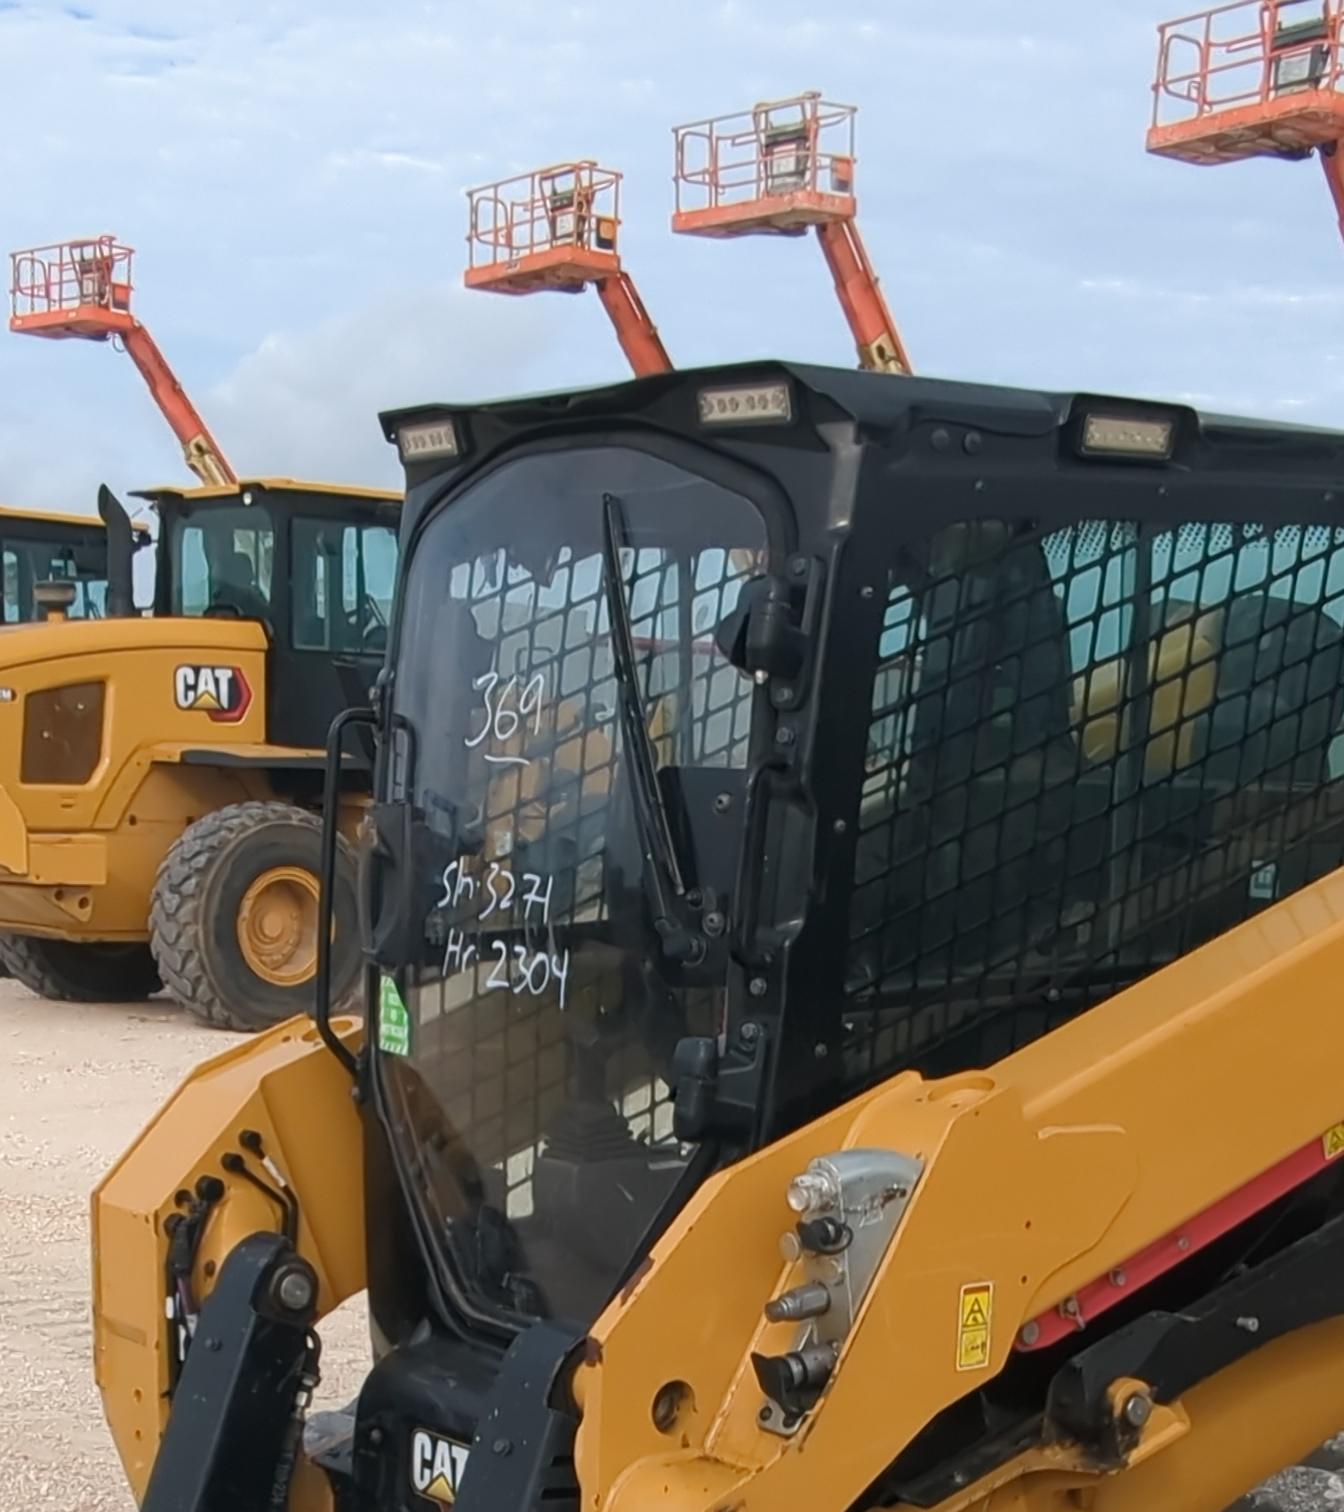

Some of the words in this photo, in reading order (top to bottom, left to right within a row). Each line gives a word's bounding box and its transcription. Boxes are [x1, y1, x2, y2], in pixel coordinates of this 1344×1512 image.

[175, 666, 233, 709] CAT
[464, 671, 545, 748] 369
[478, 861, 553, 925] 3271
[486, 939, 569, 1011] 2304
[413, 1431, 470, 1495] CAT
